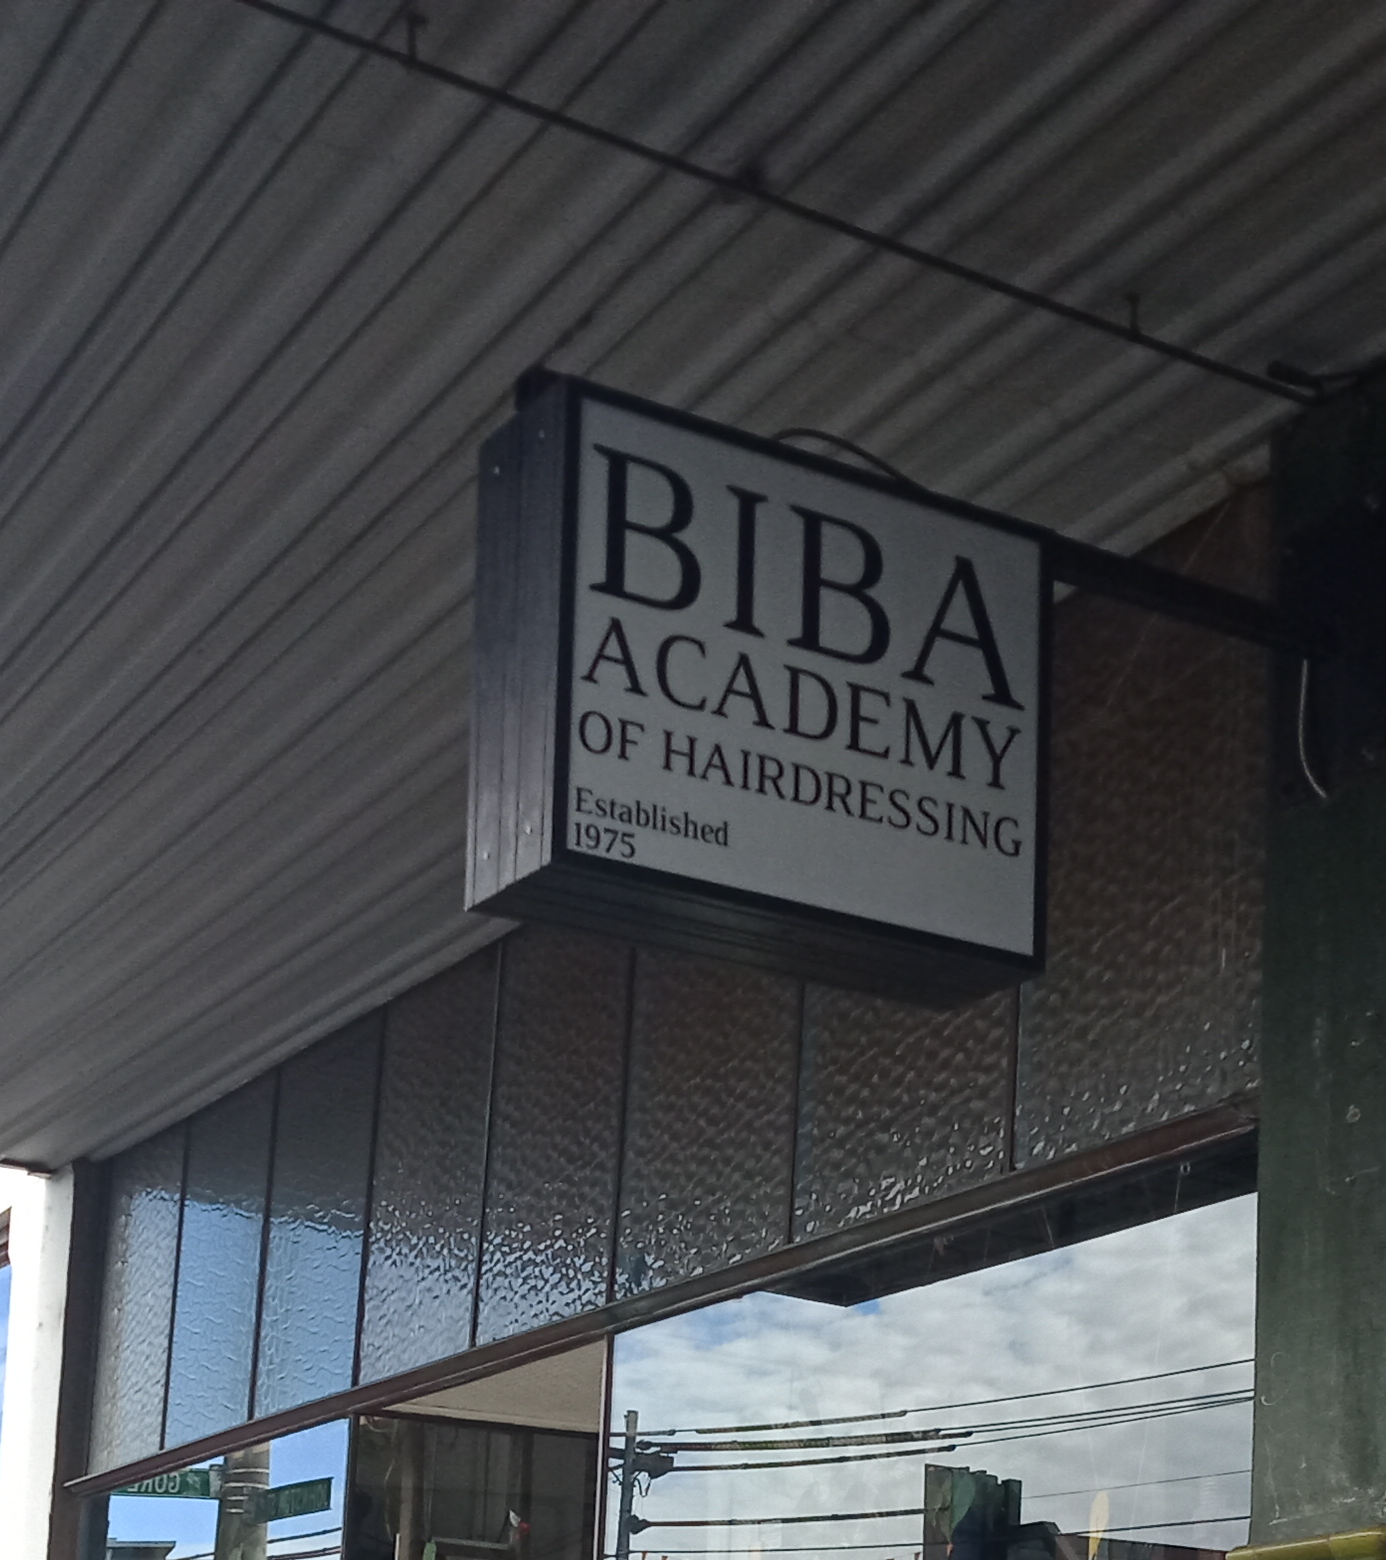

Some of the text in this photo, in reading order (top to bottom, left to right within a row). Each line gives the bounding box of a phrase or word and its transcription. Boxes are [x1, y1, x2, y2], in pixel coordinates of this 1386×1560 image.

[589, 443, 1025, 711] BIBA
[581, 616, 1022, 791] ACADEMY
[573, 820, 636, 858] 1975
[574, 786, 730, 847] Established
[578, 711, 1024, 858] OF HAIRDRESSING
